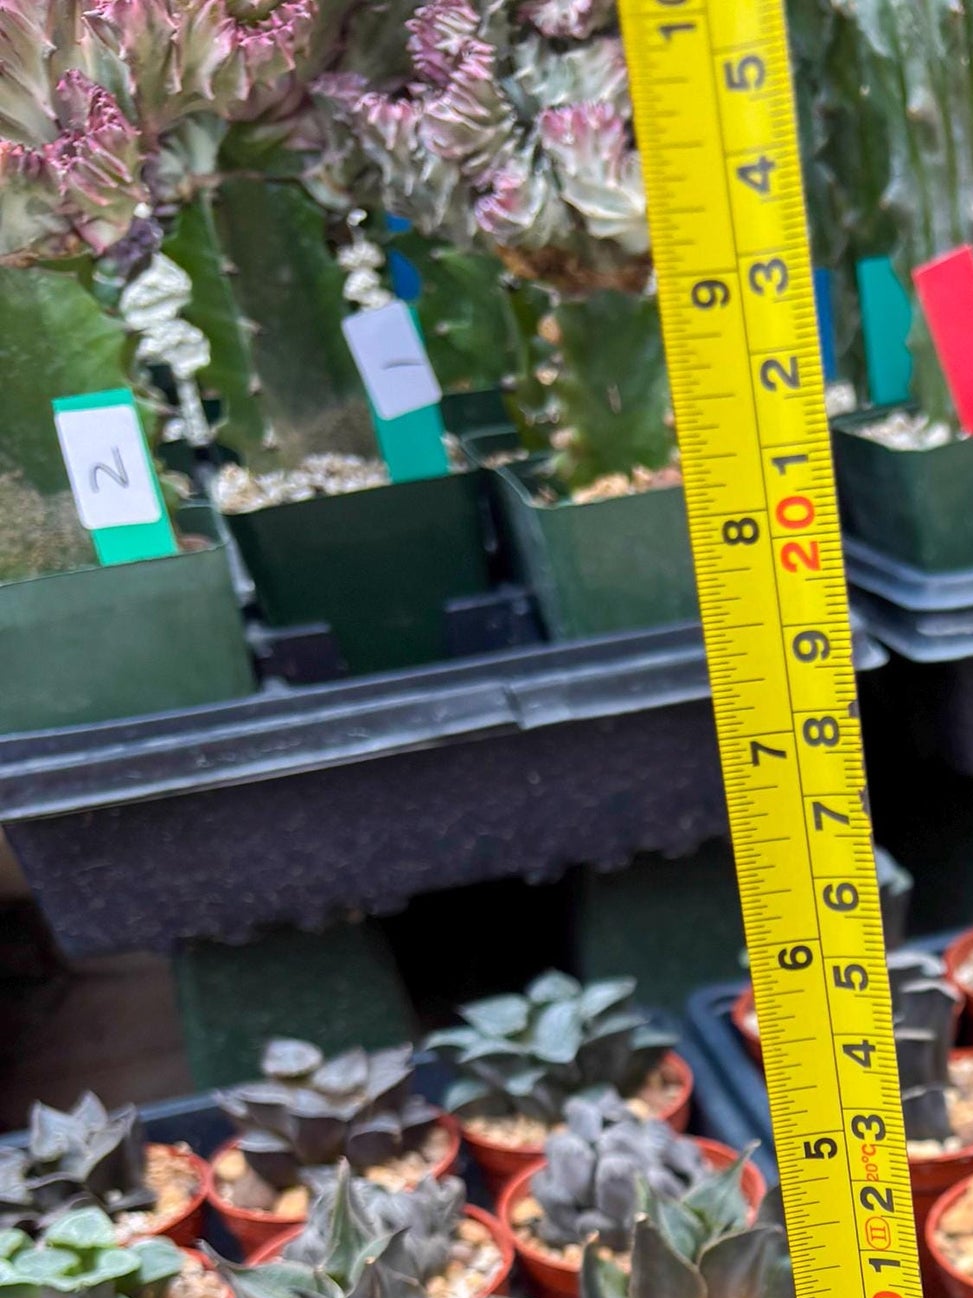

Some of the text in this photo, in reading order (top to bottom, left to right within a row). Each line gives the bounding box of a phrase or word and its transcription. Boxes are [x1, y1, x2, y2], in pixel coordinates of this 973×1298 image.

[656, 0, 697, 43] 1
[724, 56, 765, 92] 5
[736, 156, 775, 194] 4
[750, 258, 789, 296] 3
[691, 280, 730, 311] 9
[761, 356, 800, 392] 2
[772, 454, 808, 475] 1
[722, 517, 760, 545] 8
[776, 496, 821, 573] 20
[792, 630, 830, 663] 9
[803, 716, 840, 747] 8
[750, 741, 787, 767] 7
[812, 801, 850, 831] 7
[823, 882, 859, 912] 6
[778, 945, 813, 971] 6
[833, 964, 869, 992] 5
[842, 1039, 876, 1068] 4
[851, 1114, 886, 1141] 3
[804, 1138, 838, 1159] 5
[861, 1144, 879, 1182] 20°C
[860, 1186, 894, 1213] 2
[868, 1258, 901, 1272] 1
